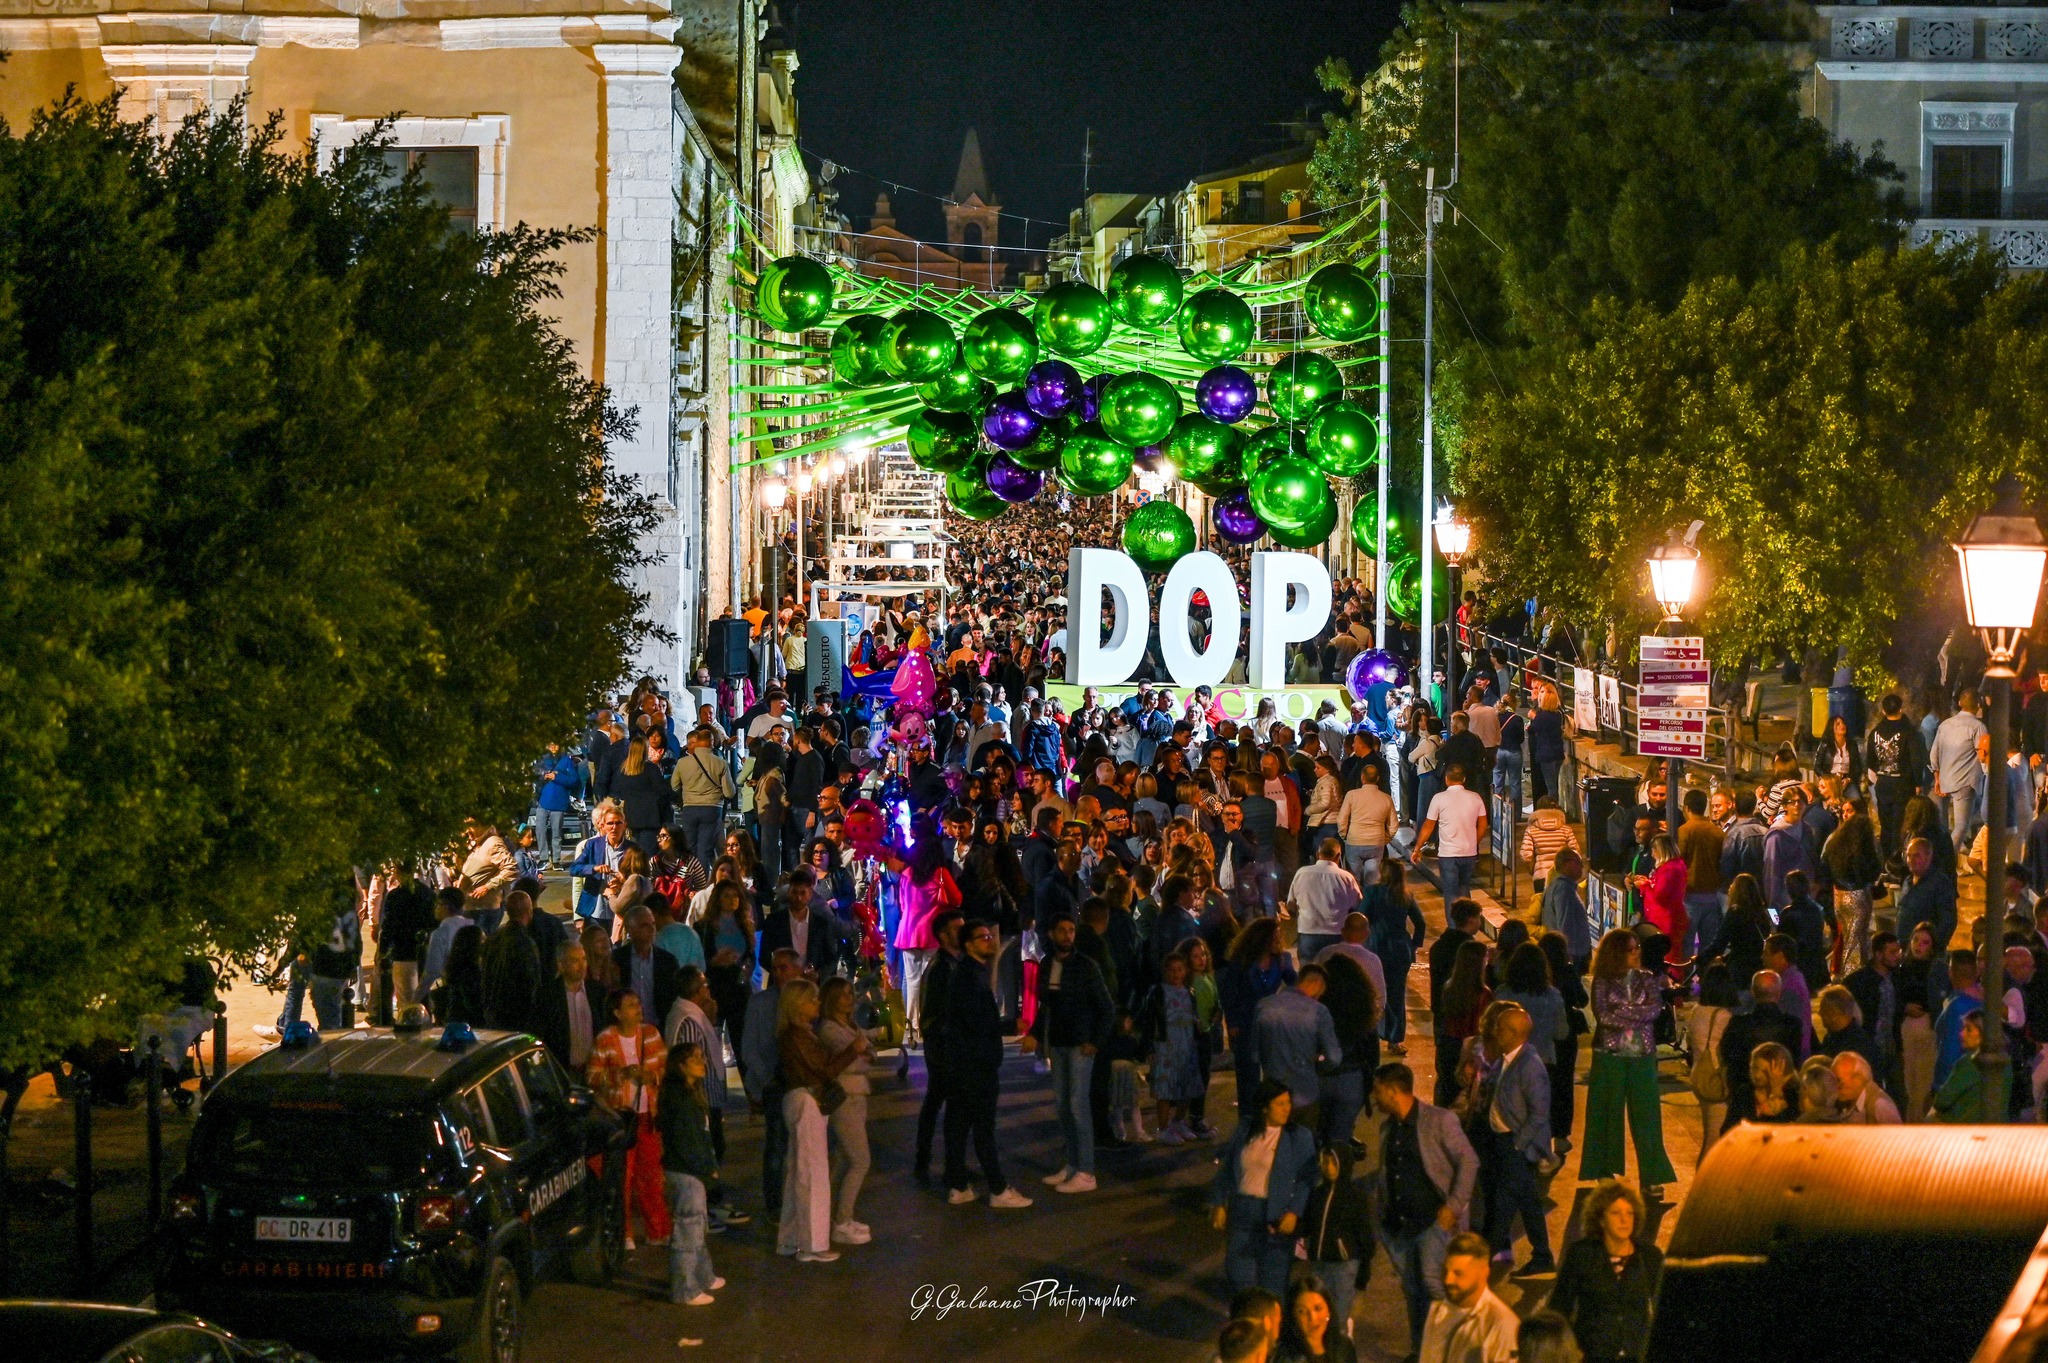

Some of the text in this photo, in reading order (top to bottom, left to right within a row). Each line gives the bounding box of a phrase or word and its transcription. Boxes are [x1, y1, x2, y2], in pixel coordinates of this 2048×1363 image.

[1066, 548, 1332, 689] DOP
[821, 636, 831, 687] BENEDETTO
[529, 1155, 587, 1217] CARABINIERI
[259, 1219, 348, 1240] CC DR 418
[222, 1261, 386, 1279] CARABINIERI
